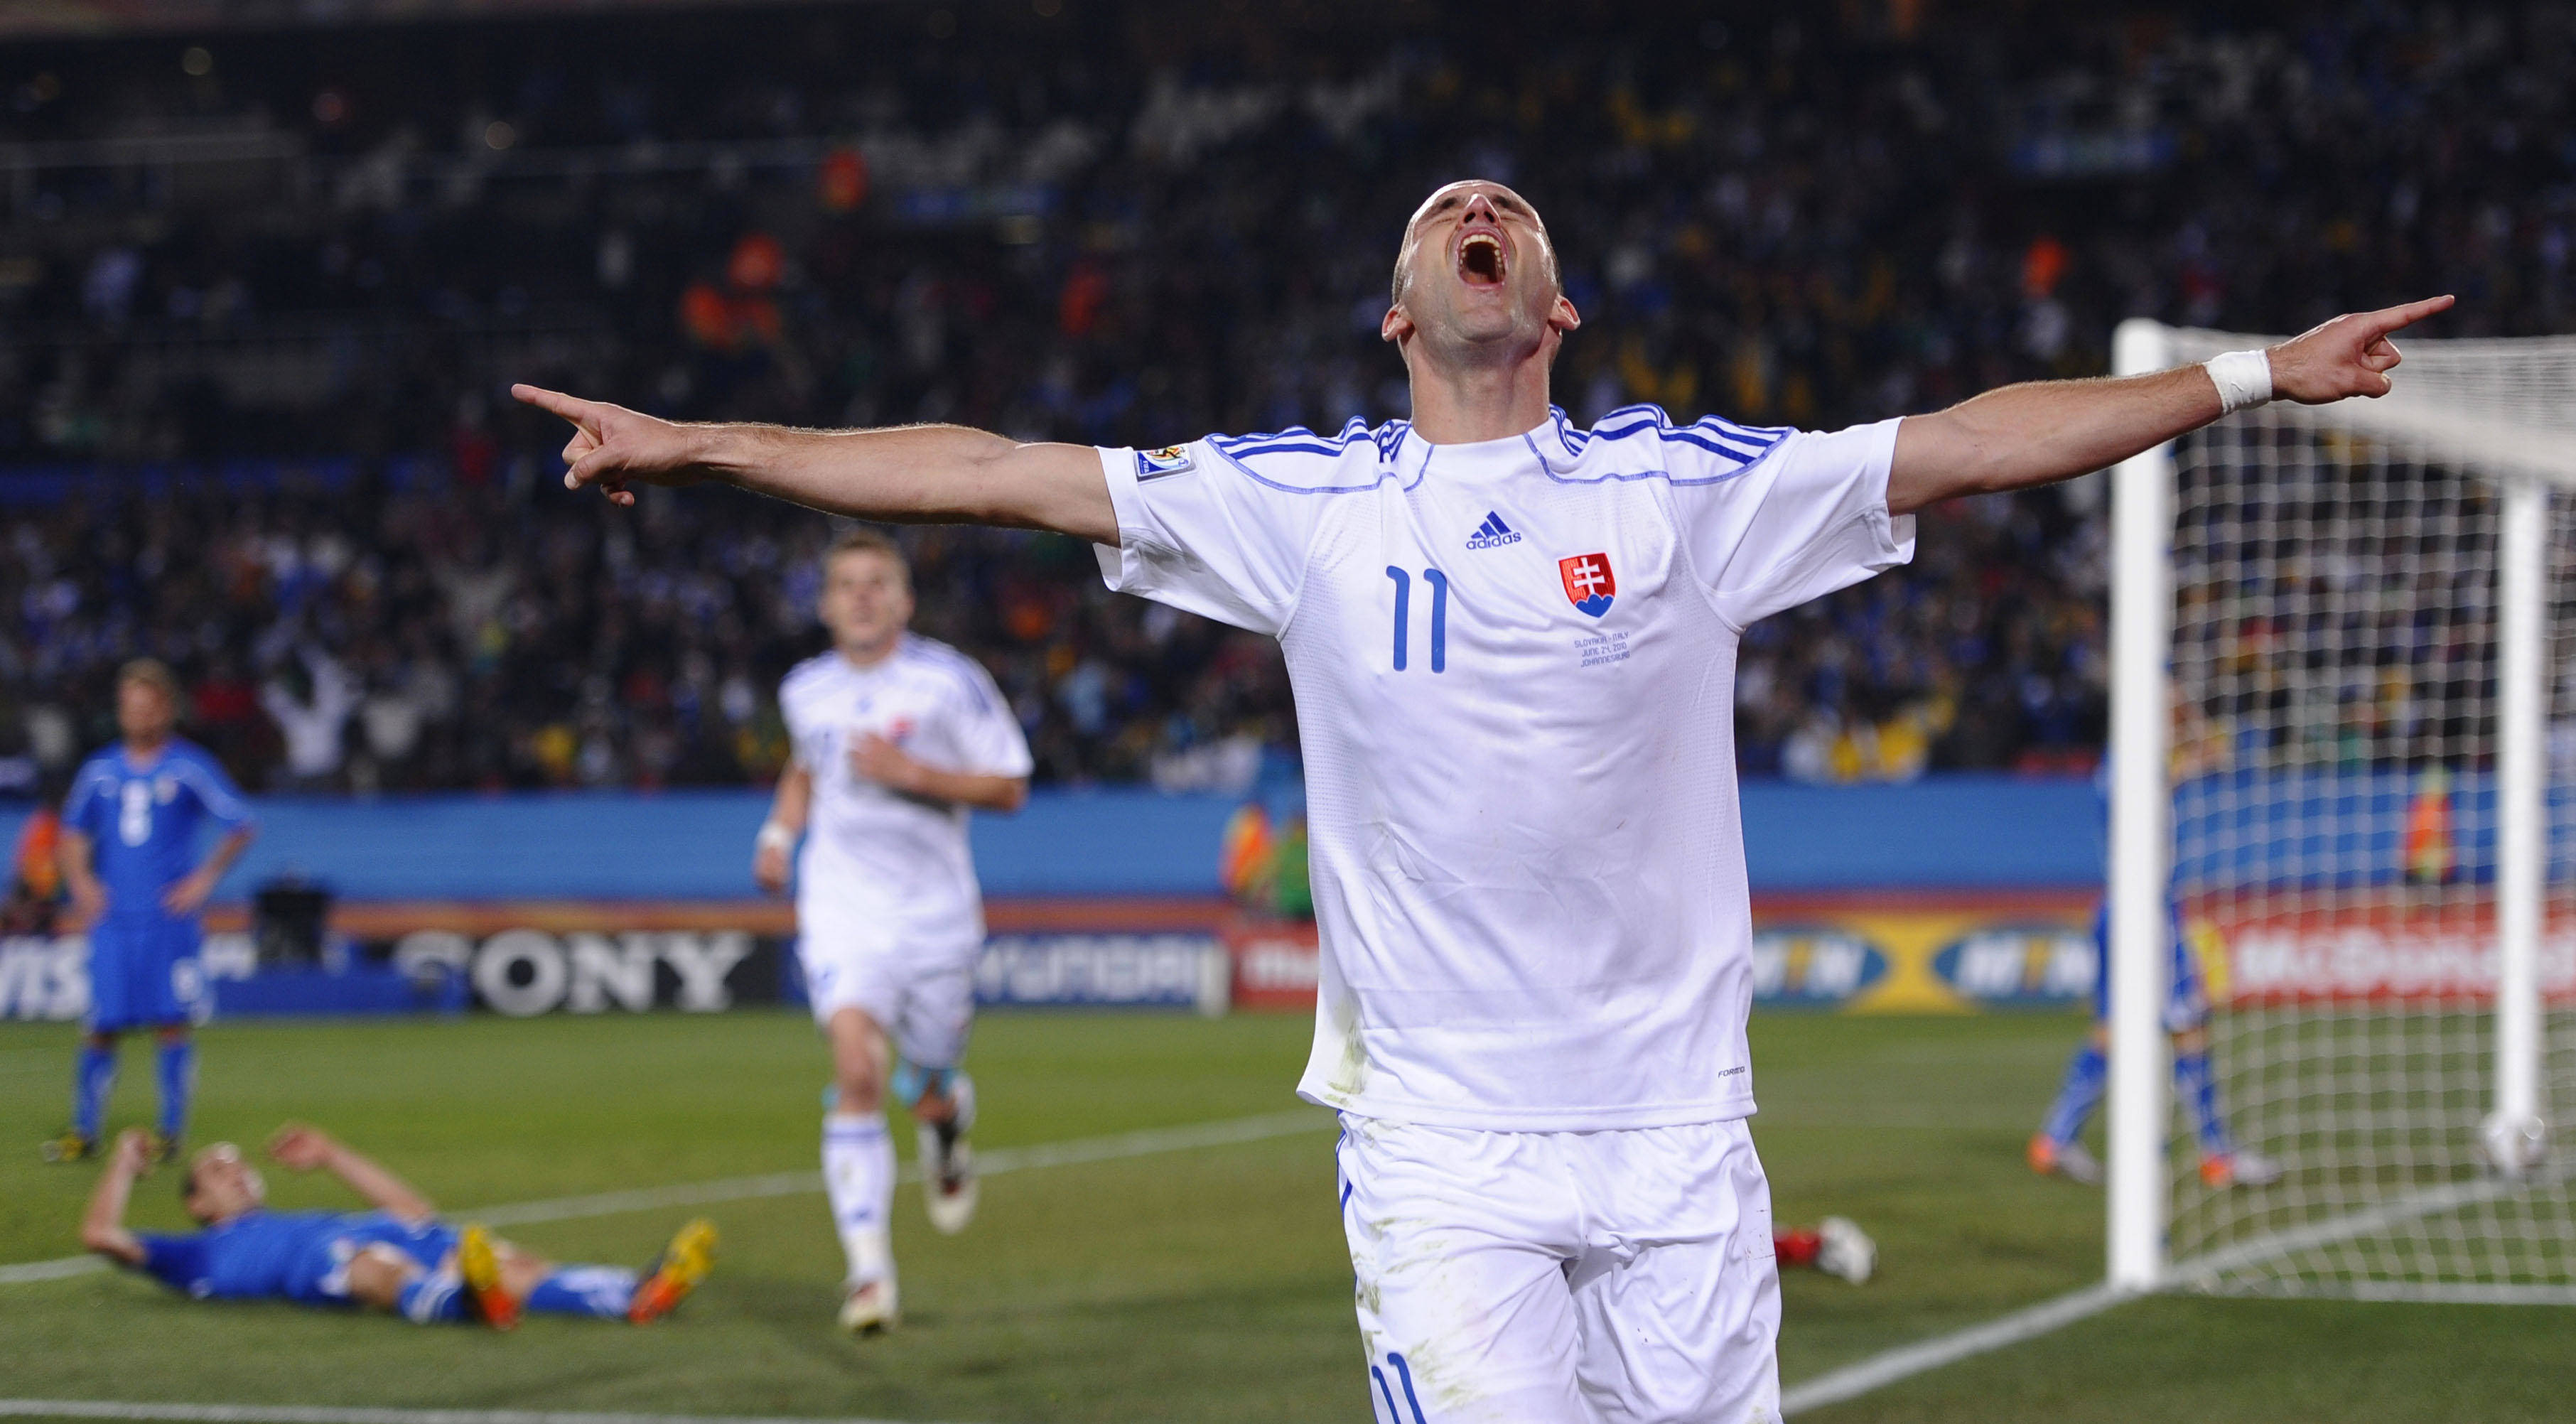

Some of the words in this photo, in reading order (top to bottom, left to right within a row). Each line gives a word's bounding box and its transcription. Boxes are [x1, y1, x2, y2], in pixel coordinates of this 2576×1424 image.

[1465, 532, 1522, 550] adidas
[1385, 564, 1448, 674] 11
[1612, 631, 1629, 642] ITALY
[1582, 647, 1600, 657] JUNE
[1612, 642, 1627, 652] 2010
[392, 929, 756, 1016] SONY
[1371, 1352, 1428, 1424] 11
